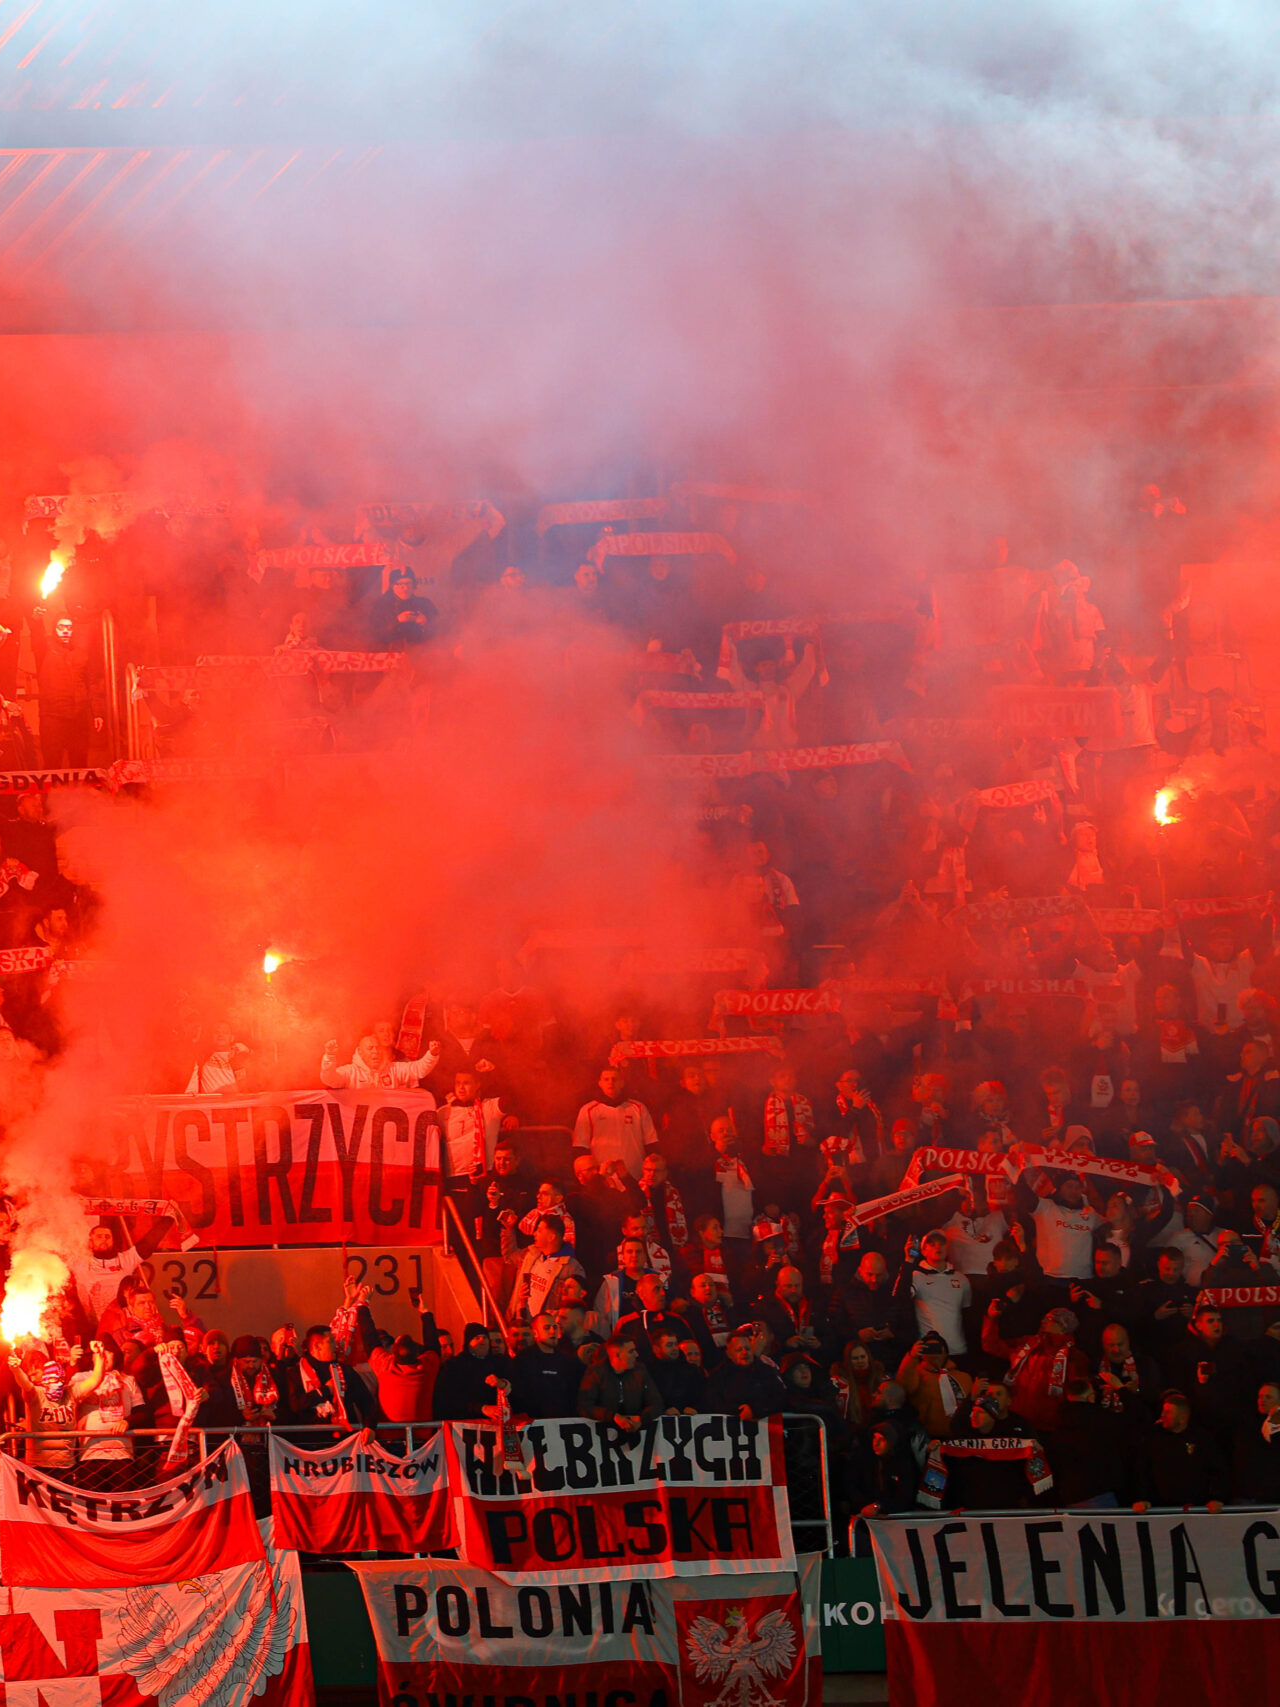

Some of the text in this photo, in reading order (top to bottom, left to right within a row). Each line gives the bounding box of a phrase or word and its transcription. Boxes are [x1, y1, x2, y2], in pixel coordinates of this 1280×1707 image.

[283, 545, 366, 566] POLSKA
[984, 978, 1076, 993] POLSKA
[738, 990, 832, 1012] POLSKA
[1040, 1146, 1139, 1177] POLSKA
[879, 1182, 942, 1211] POLSKA
[1056, 1219, 1091, 1233] POLSKA
[283, 1451, 439, 1481] HRUBIESZÓW
[16, 1452, 229, 1525] KĘTRZYN
[485, 1496, 754, 1565] POLSKA
[898, 1520, 1214, 1620] JELENIA
[395, 1582, 656, 1638] POLONIA
